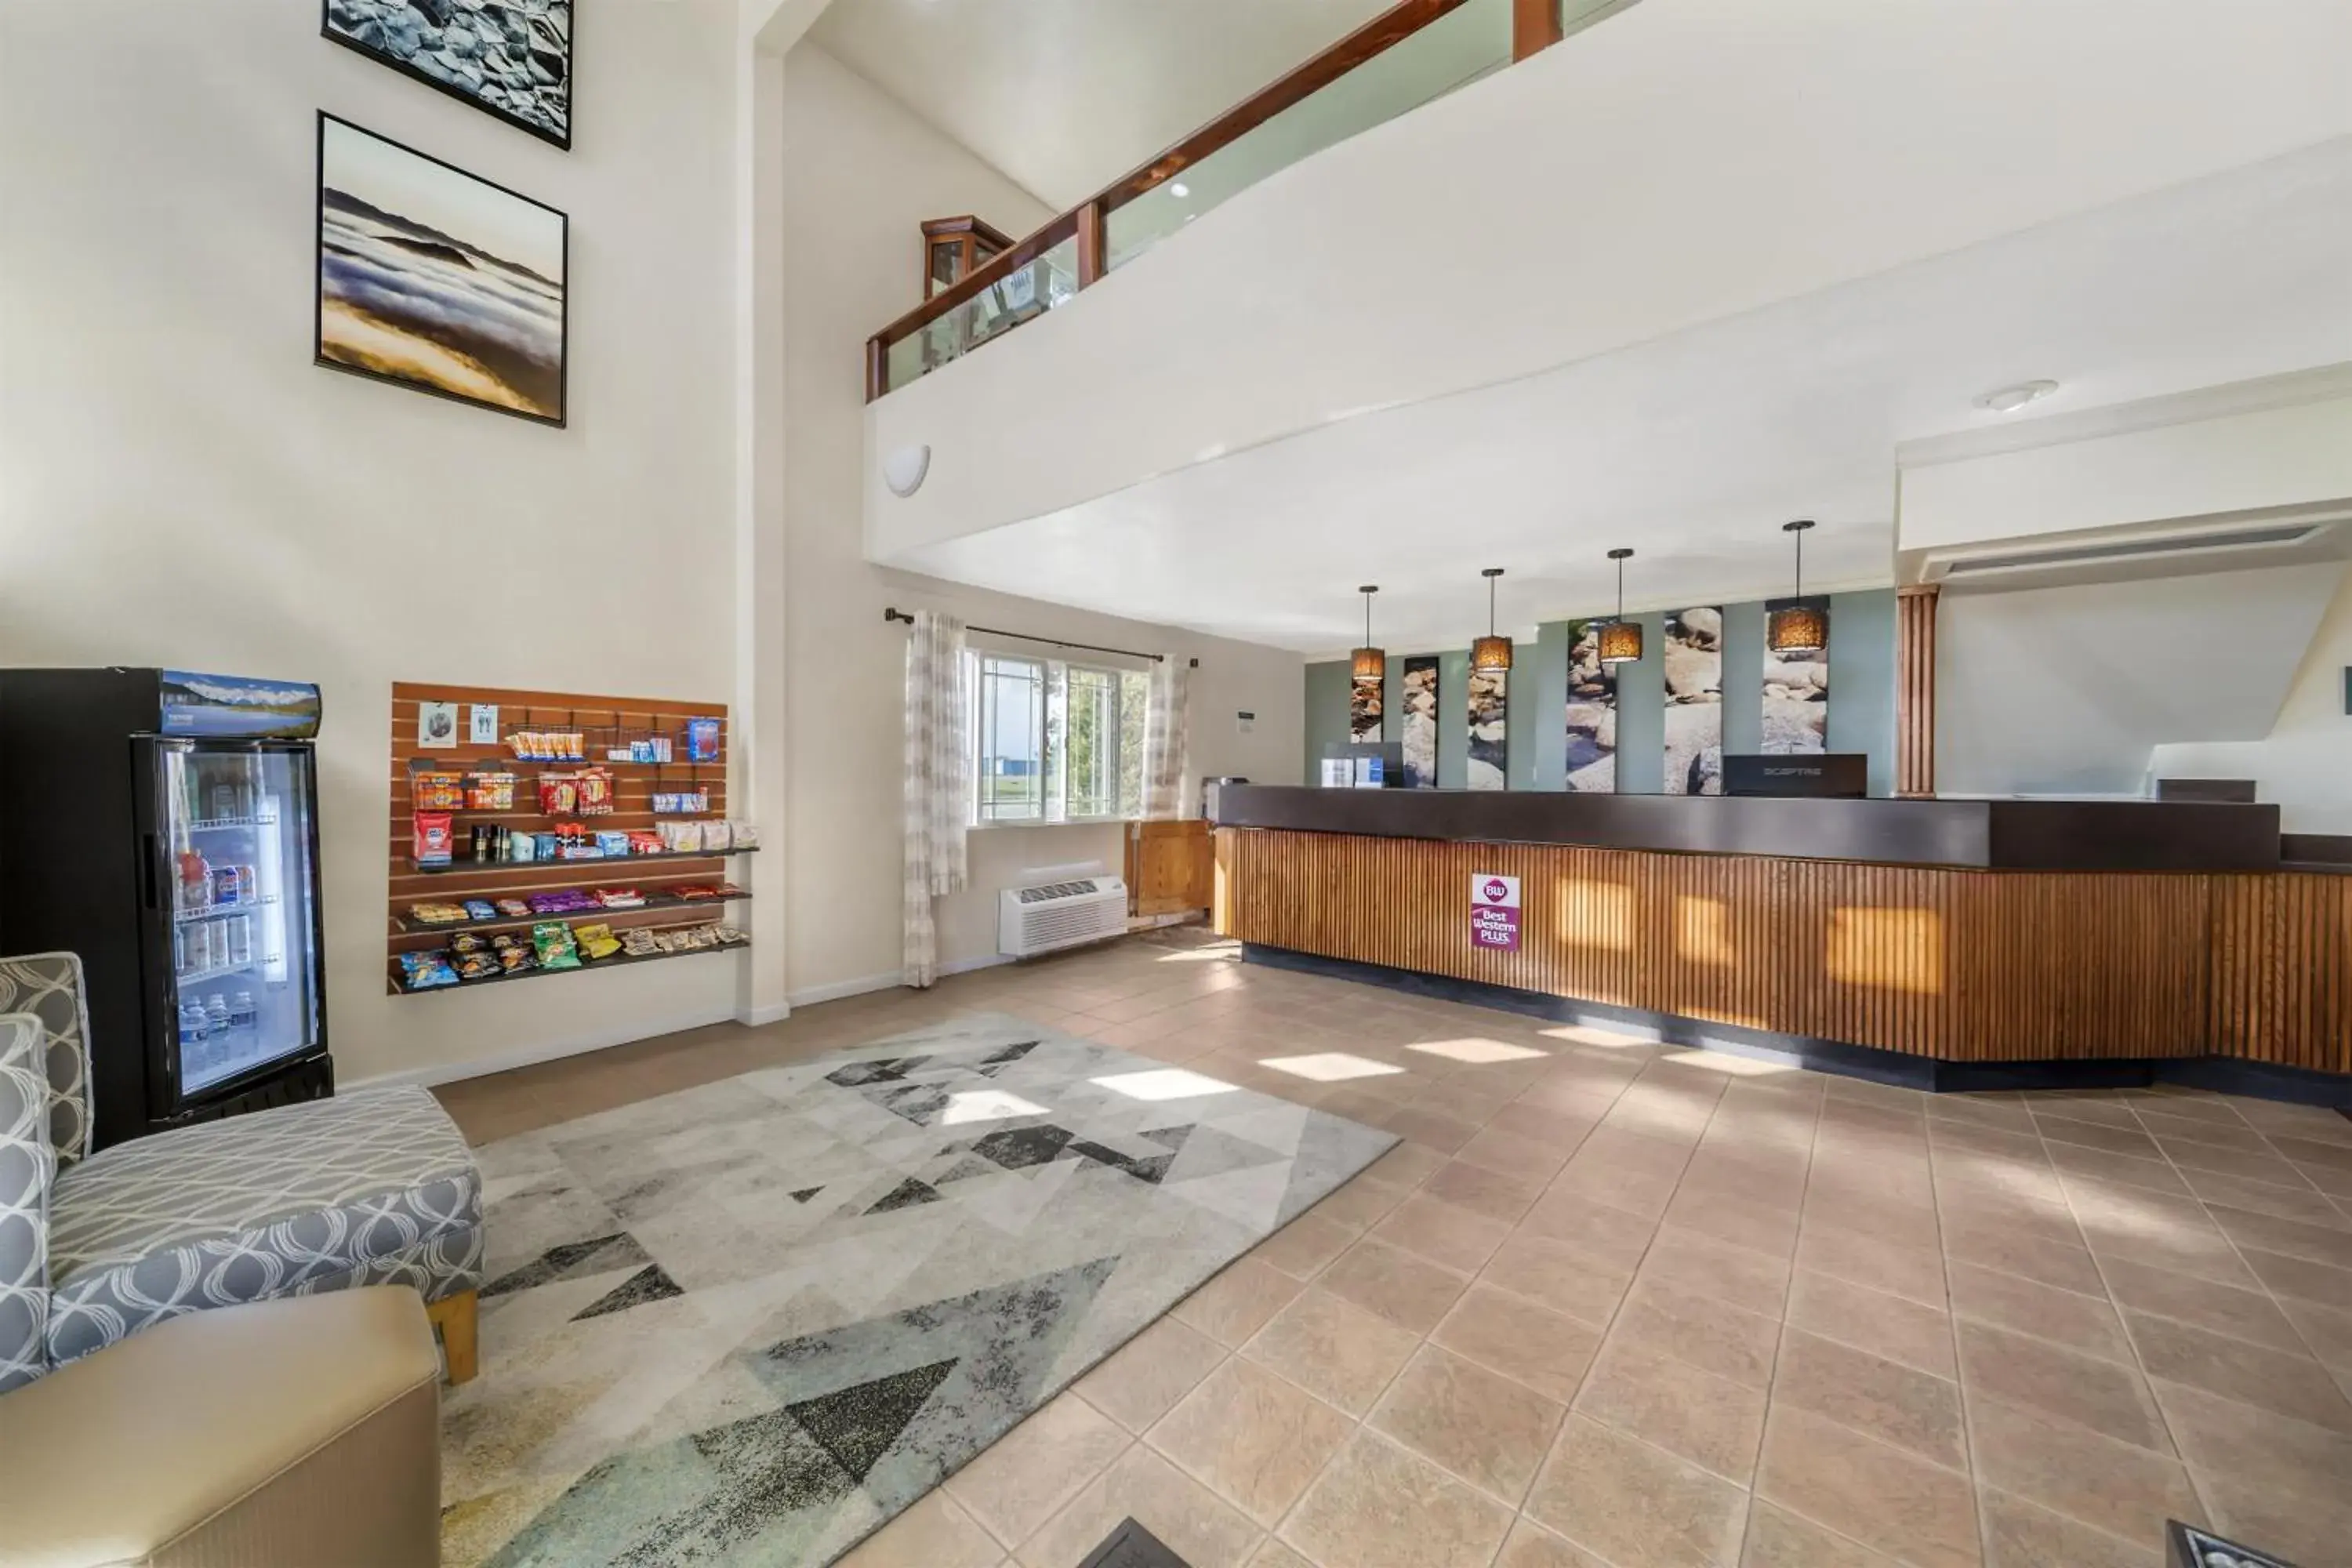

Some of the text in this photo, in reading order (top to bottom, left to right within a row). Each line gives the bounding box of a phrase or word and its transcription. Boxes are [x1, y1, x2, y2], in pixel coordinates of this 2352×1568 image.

[1486, 885, 1504, 896] BW
[1483, 910, 1507, 921] Best
[1481, 929, 1509, 942] PLUS
